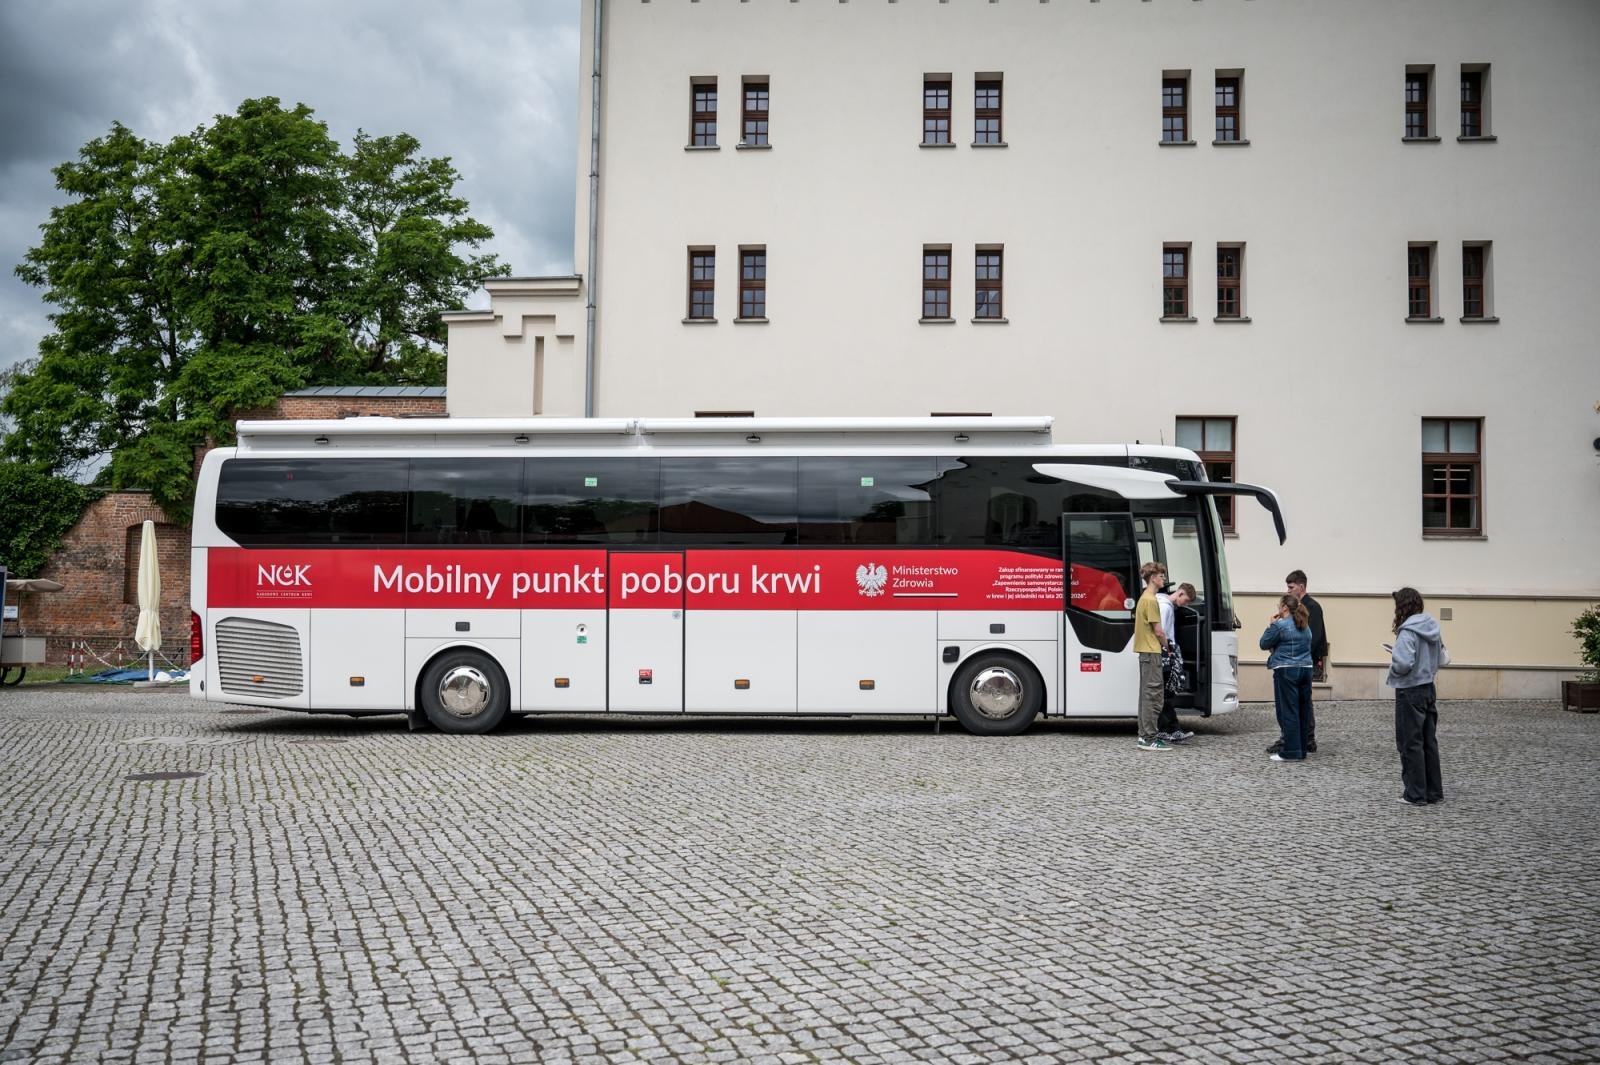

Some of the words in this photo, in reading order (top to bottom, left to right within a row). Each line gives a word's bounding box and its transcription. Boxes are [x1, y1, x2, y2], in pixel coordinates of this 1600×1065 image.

[892, 565, 958, 575] Ministerstwo
[373, 564, 501, 599] Mobilny
[512, 564, 604, 599] punkt
[621, 564, 740, 599] poboru
[751, 564, 821, 594] krwi
[892, 578, 934, 588] Zdrowia
